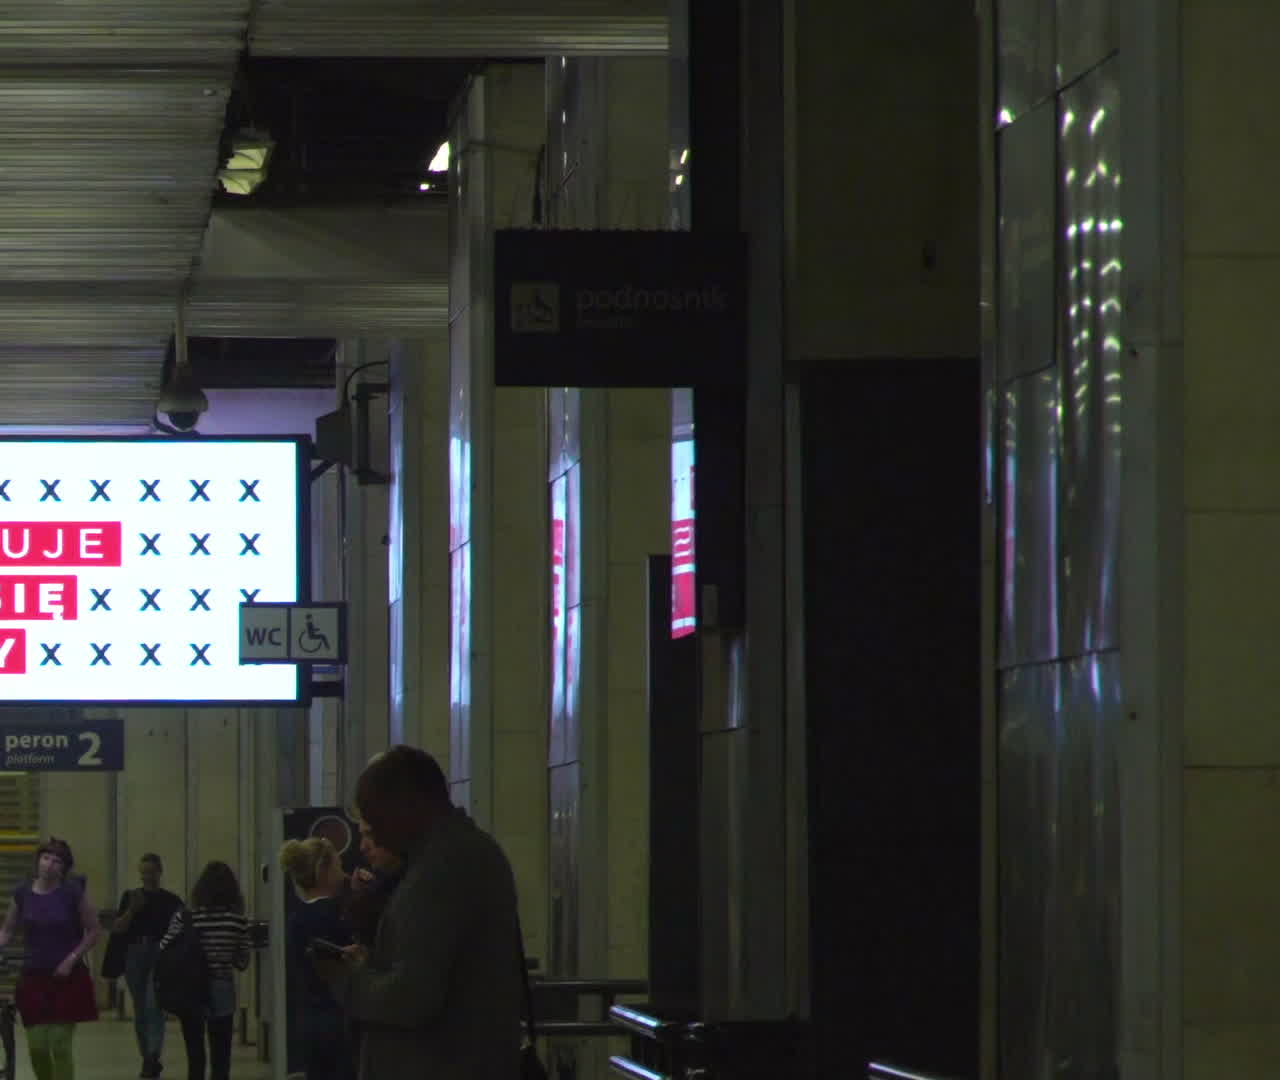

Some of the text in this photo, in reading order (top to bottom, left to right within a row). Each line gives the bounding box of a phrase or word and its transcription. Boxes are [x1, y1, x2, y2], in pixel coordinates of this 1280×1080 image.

[245, 627, 282, 647] WC
[5, 730, 104, 766] peron 2
[5, 752, 56, 767] platform
